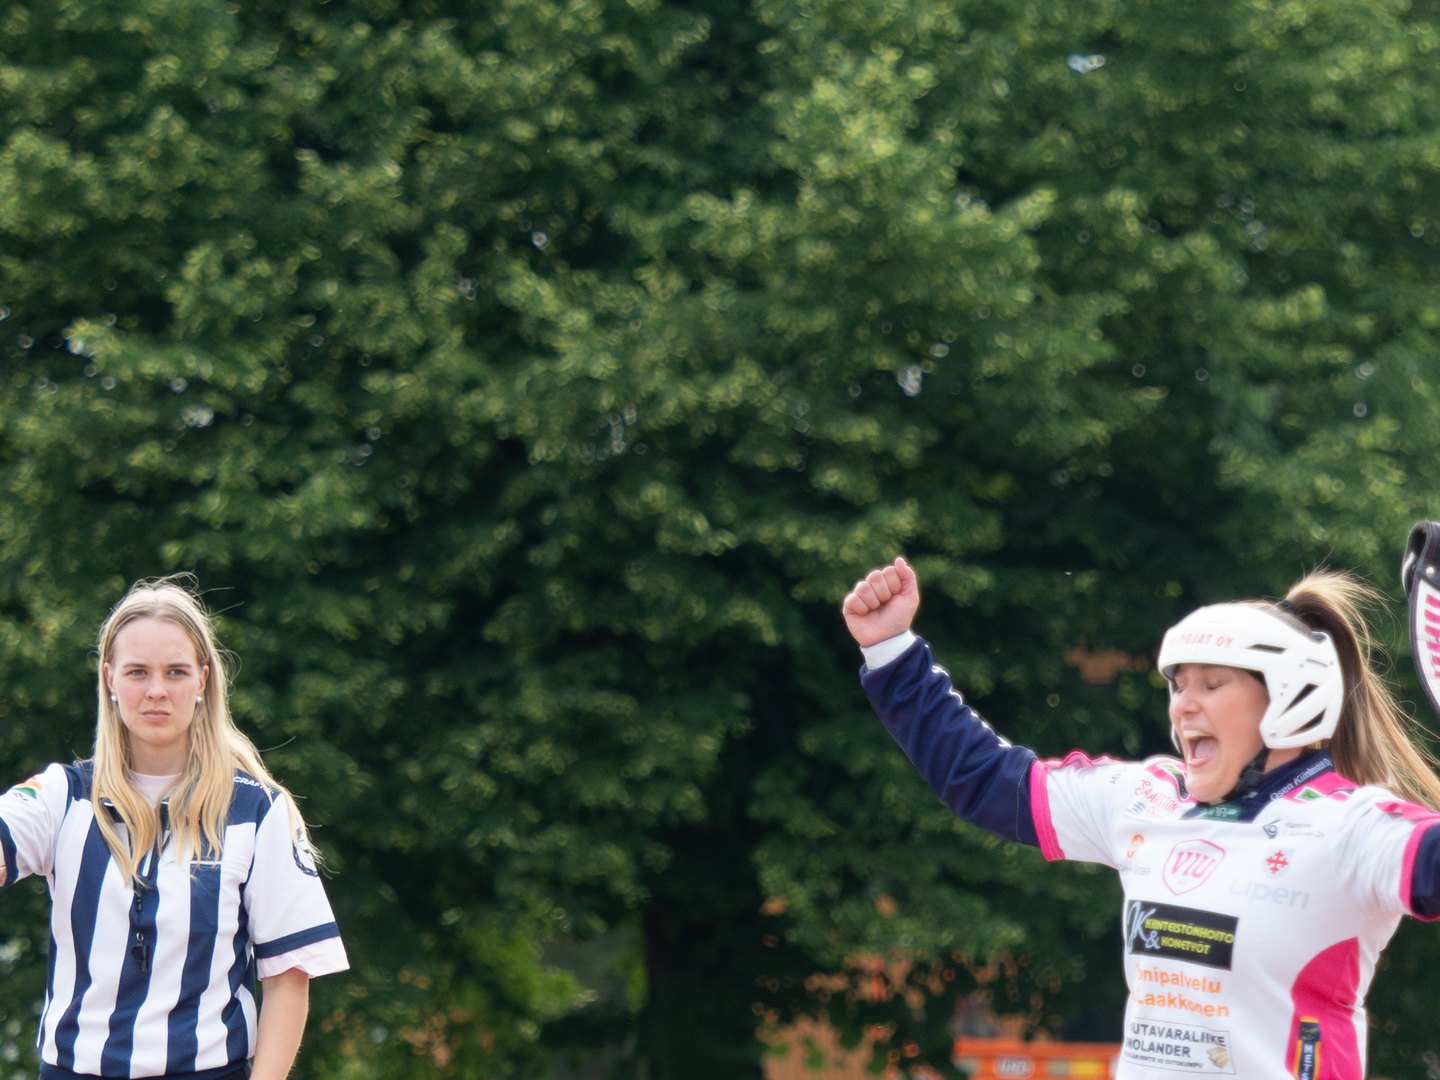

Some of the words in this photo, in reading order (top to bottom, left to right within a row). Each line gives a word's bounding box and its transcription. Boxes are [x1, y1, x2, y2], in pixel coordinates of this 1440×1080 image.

[234, 776, 266, 790] CRAF
[1171, 851, 1217, 878] VIU
[1161, 936, 1212, 955] KONETYÖT
